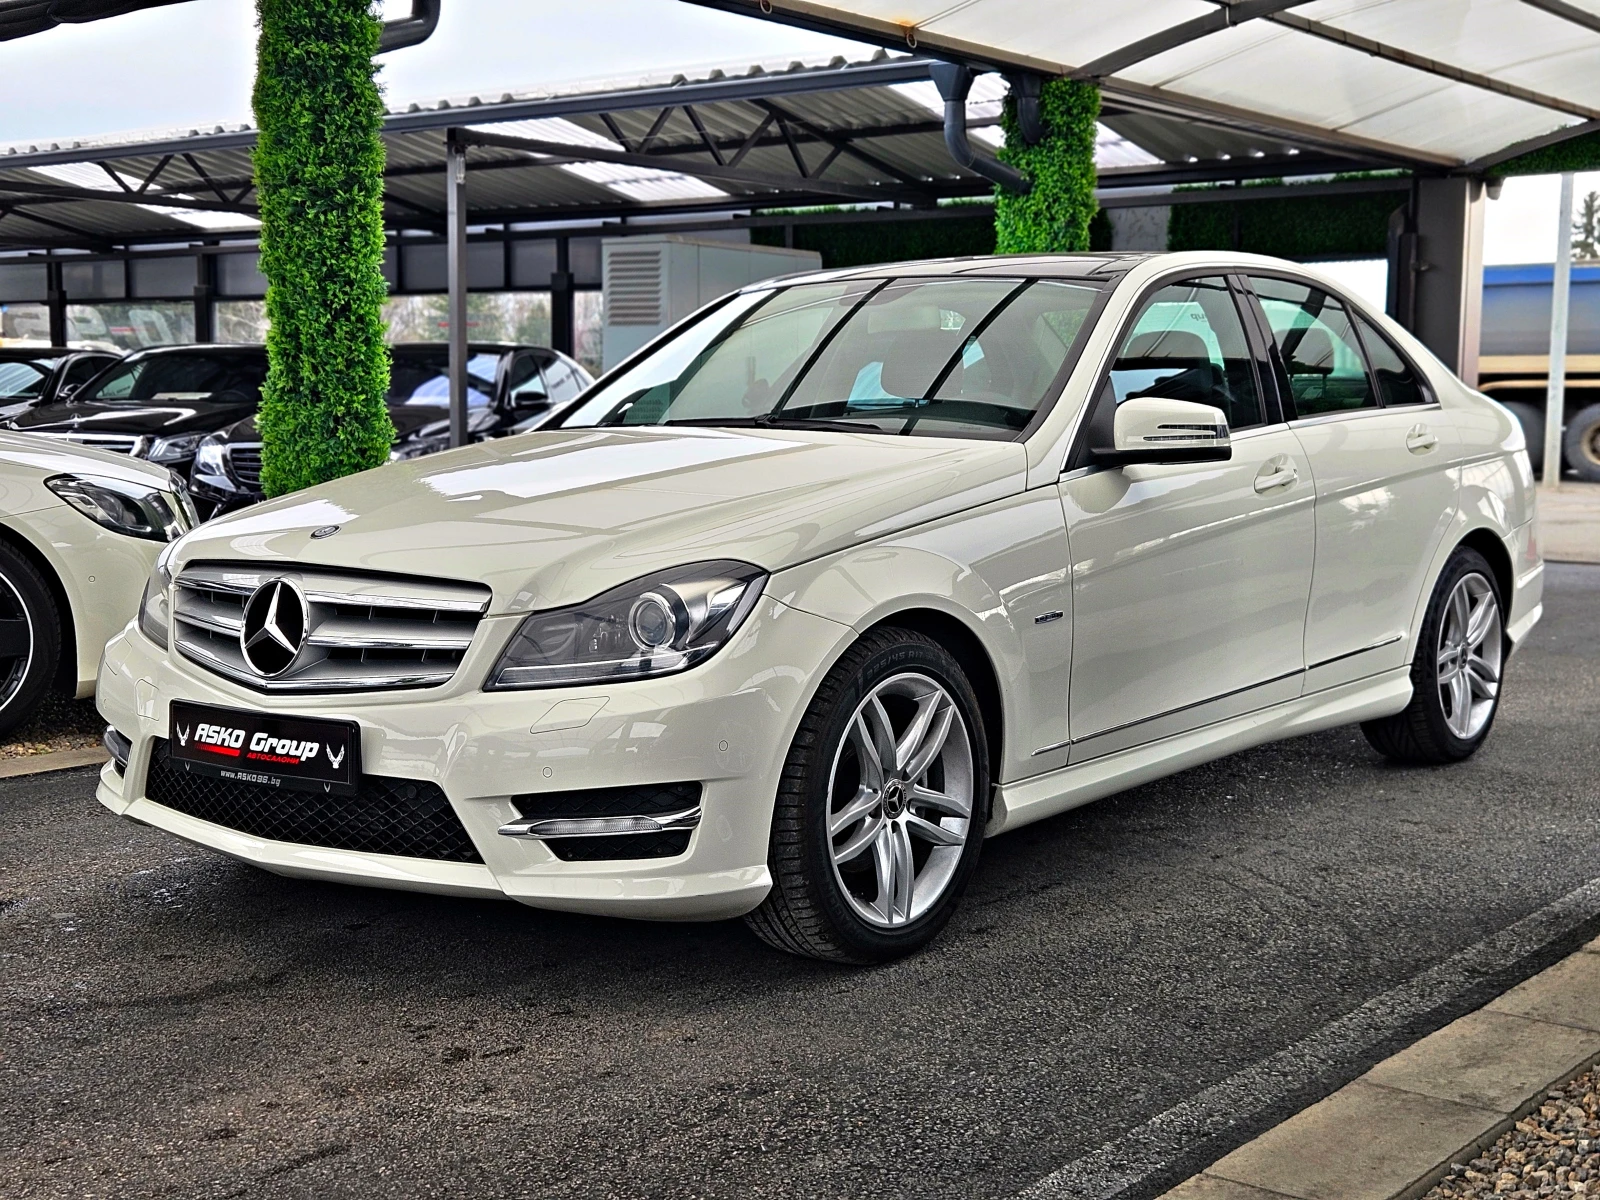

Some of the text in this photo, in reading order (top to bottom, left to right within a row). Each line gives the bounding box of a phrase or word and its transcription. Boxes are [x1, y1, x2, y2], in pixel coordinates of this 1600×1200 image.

[194, 723, 320, 762] ASKO Group
[220, 770, 281, 787] www.ASKO96.bg
